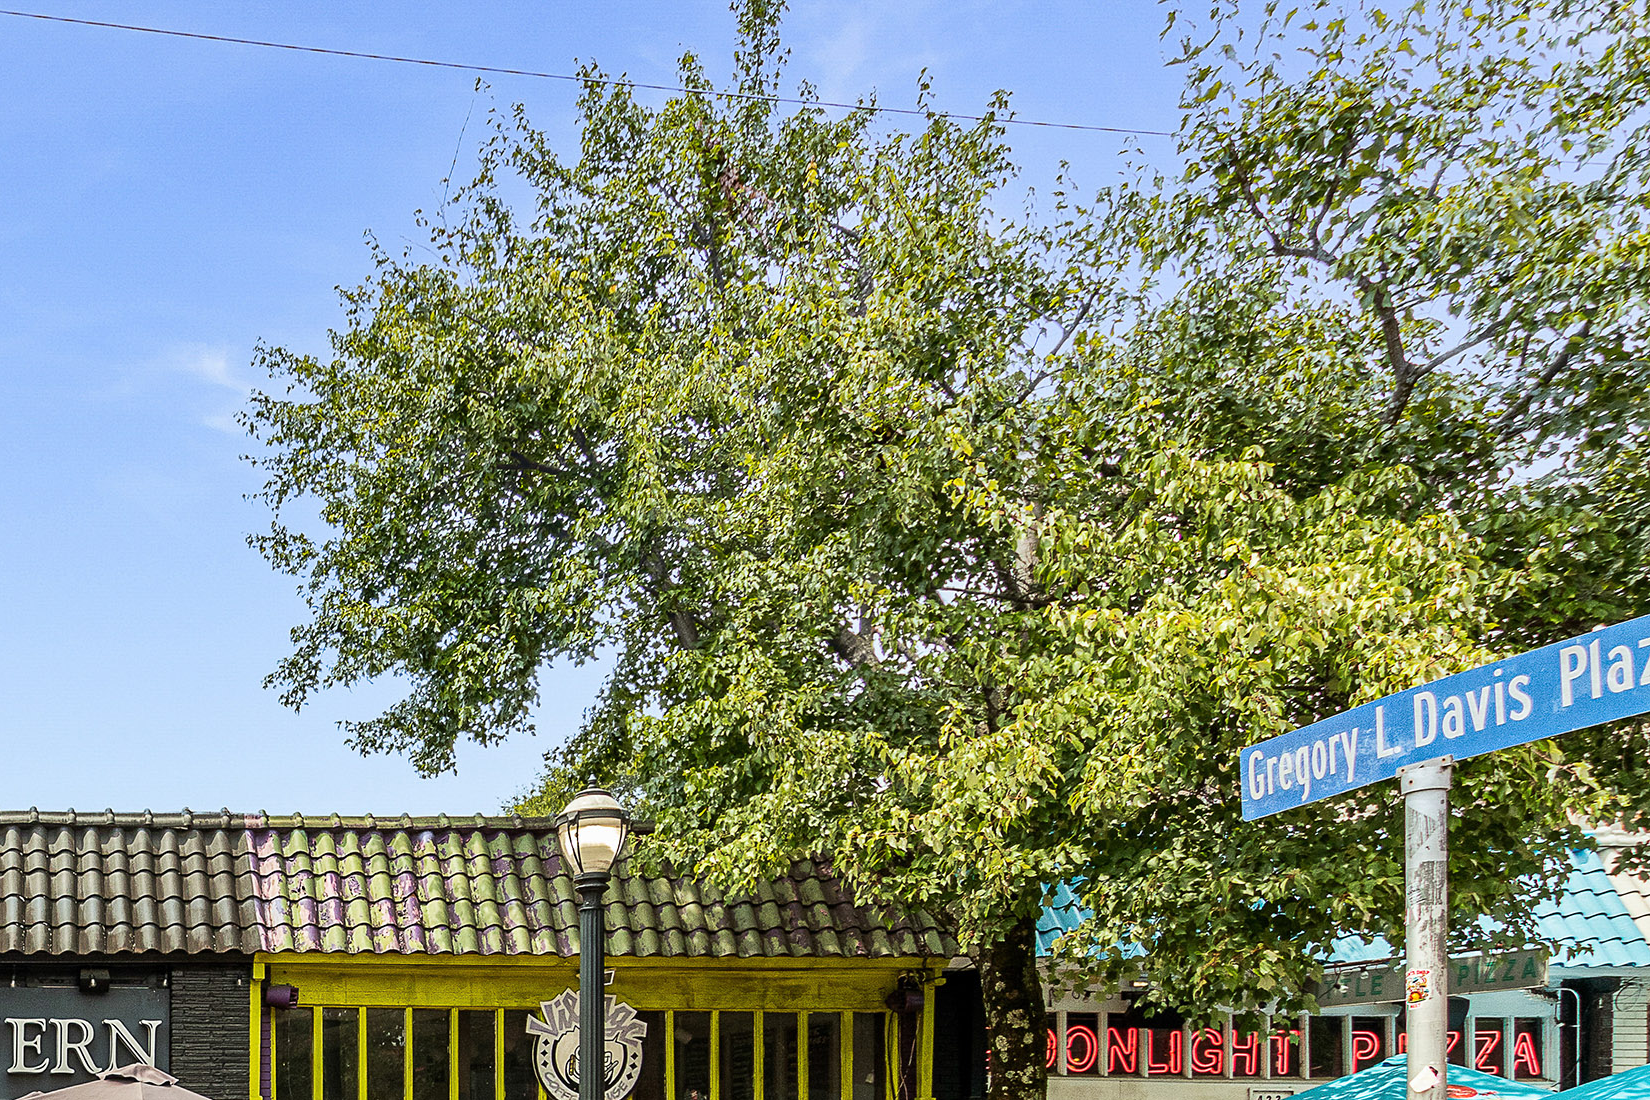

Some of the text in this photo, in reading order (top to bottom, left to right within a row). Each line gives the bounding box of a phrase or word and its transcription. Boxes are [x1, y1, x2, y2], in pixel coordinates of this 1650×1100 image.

[1248, 726, 1359, 802] Gregory
[1375, 705, 1402, 760] L.
[1413, 667, 1533, 749] Davis
[1046, 1025, 1540, 1076] ONLIGHT PZA
